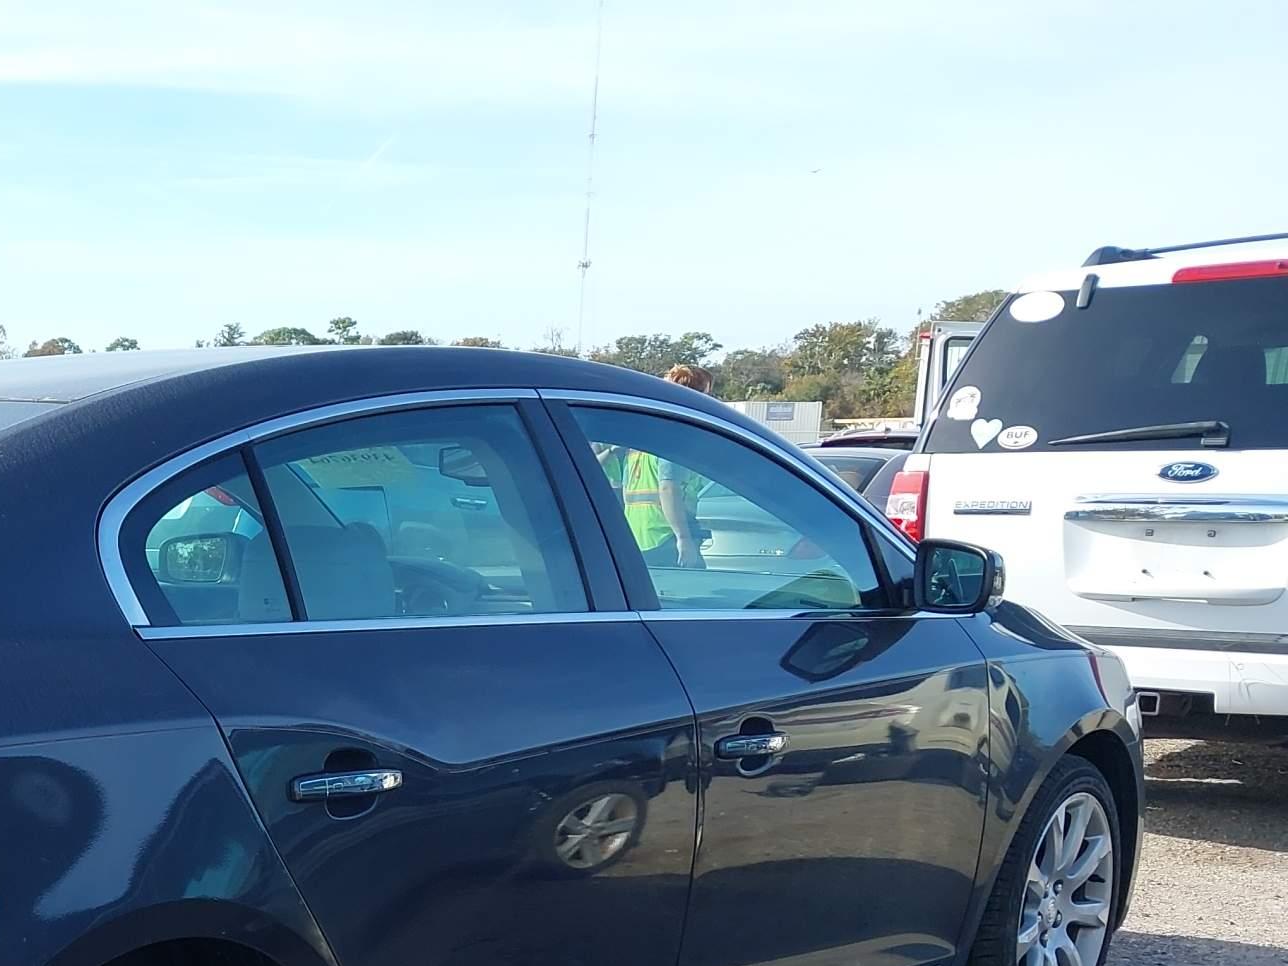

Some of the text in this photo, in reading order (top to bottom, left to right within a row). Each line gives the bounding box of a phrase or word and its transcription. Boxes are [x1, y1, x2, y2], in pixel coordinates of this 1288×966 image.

[1006, 430, 1030, 439] BUF
[1167, 463, 1204, 477] Ford
[954, 500, 1030, 509] EXPEDITION
